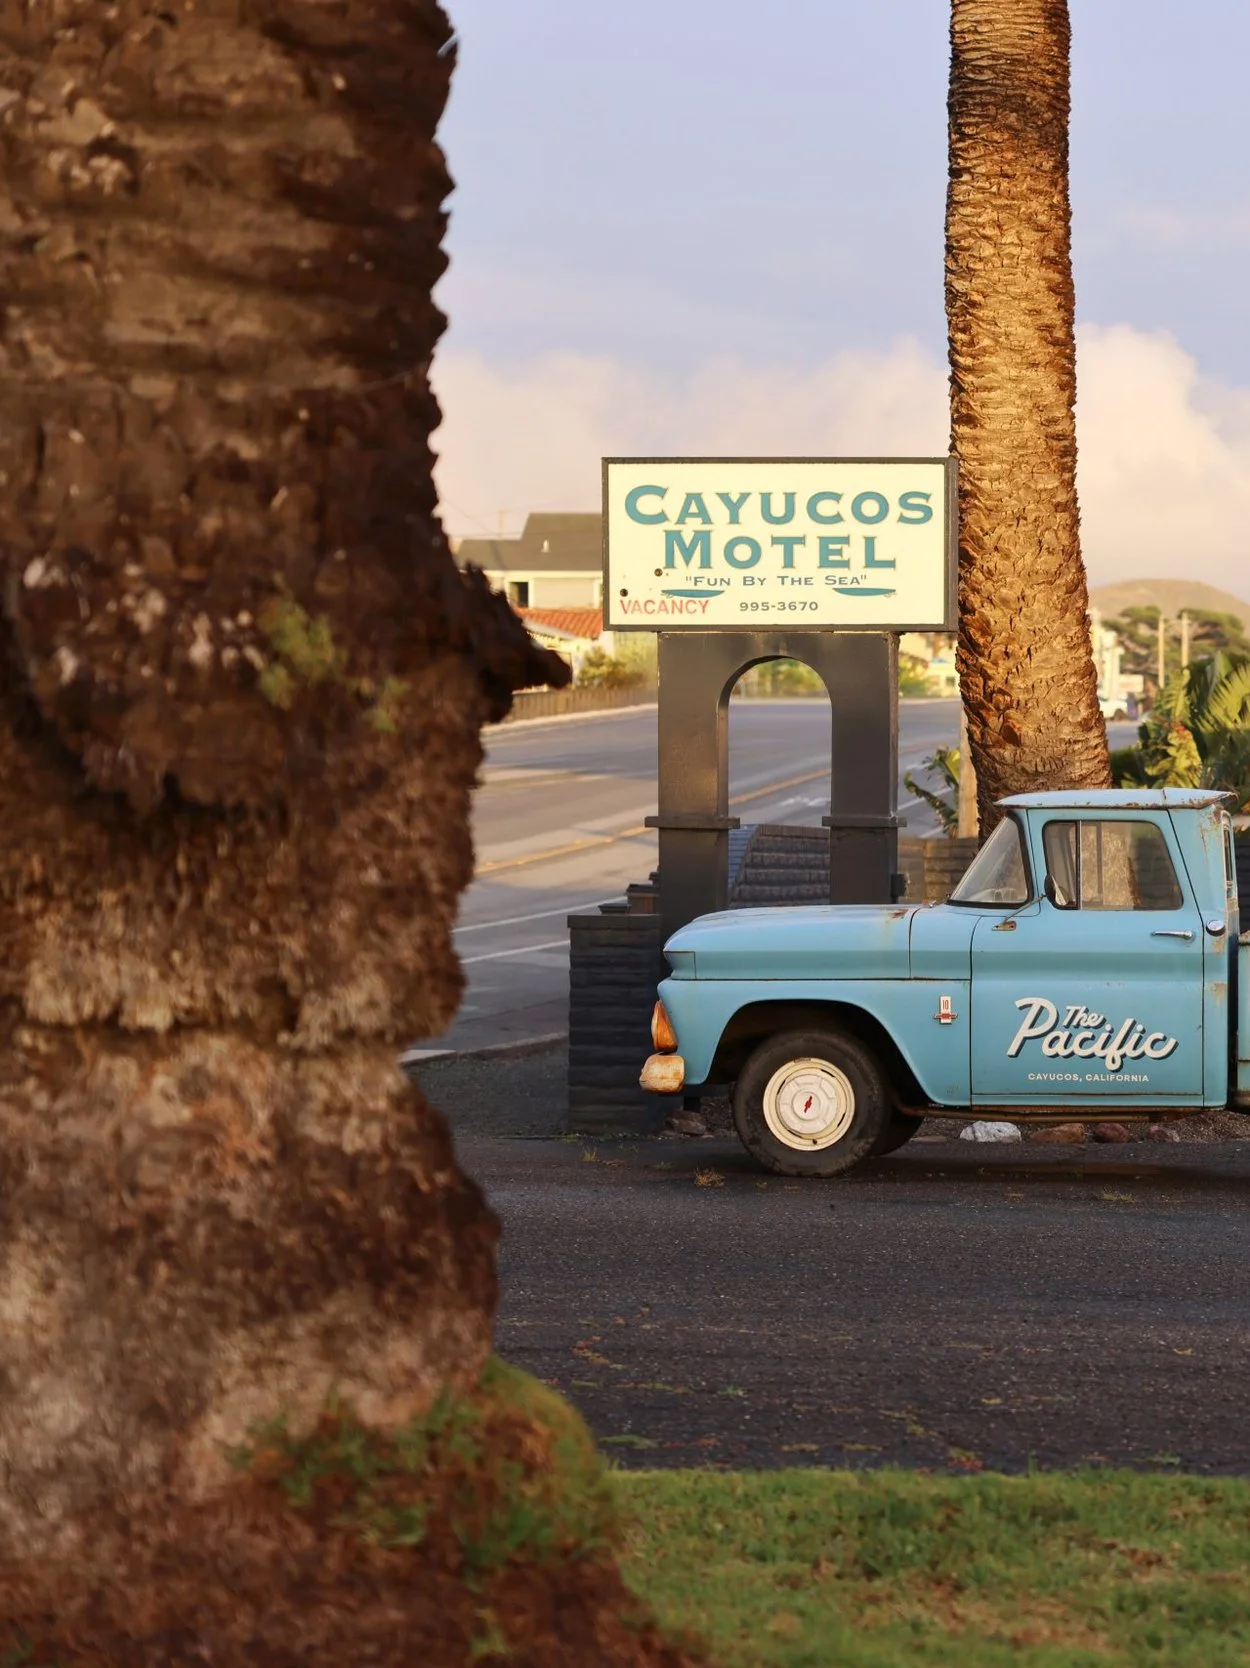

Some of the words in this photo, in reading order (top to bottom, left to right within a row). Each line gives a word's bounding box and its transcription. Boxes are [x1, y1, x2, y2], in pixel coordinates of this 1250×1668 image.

[624, 484, 934, 526] CAYUCOS
[662, 529, 897, 570] MOTEL
[685, 575, 731, 587] "FUN
[742, 575, 767, 587] BY
[777, 575, 814, 586] THE
[824, 574, 867, 586] SEA"
[620, 599, 709, 615] VACANCY
[739, 601, 819, 612] 995-3670
[942, 999, 949, 1010] 10
[1064, 1005, 1107, 1029] The
[1006, 997, 1178, 1072] Pacific
[1027, 1072, 1083, 1082] CAYUCOS,
[1085, 1073, 1149, 1082] CALIFORNIA
